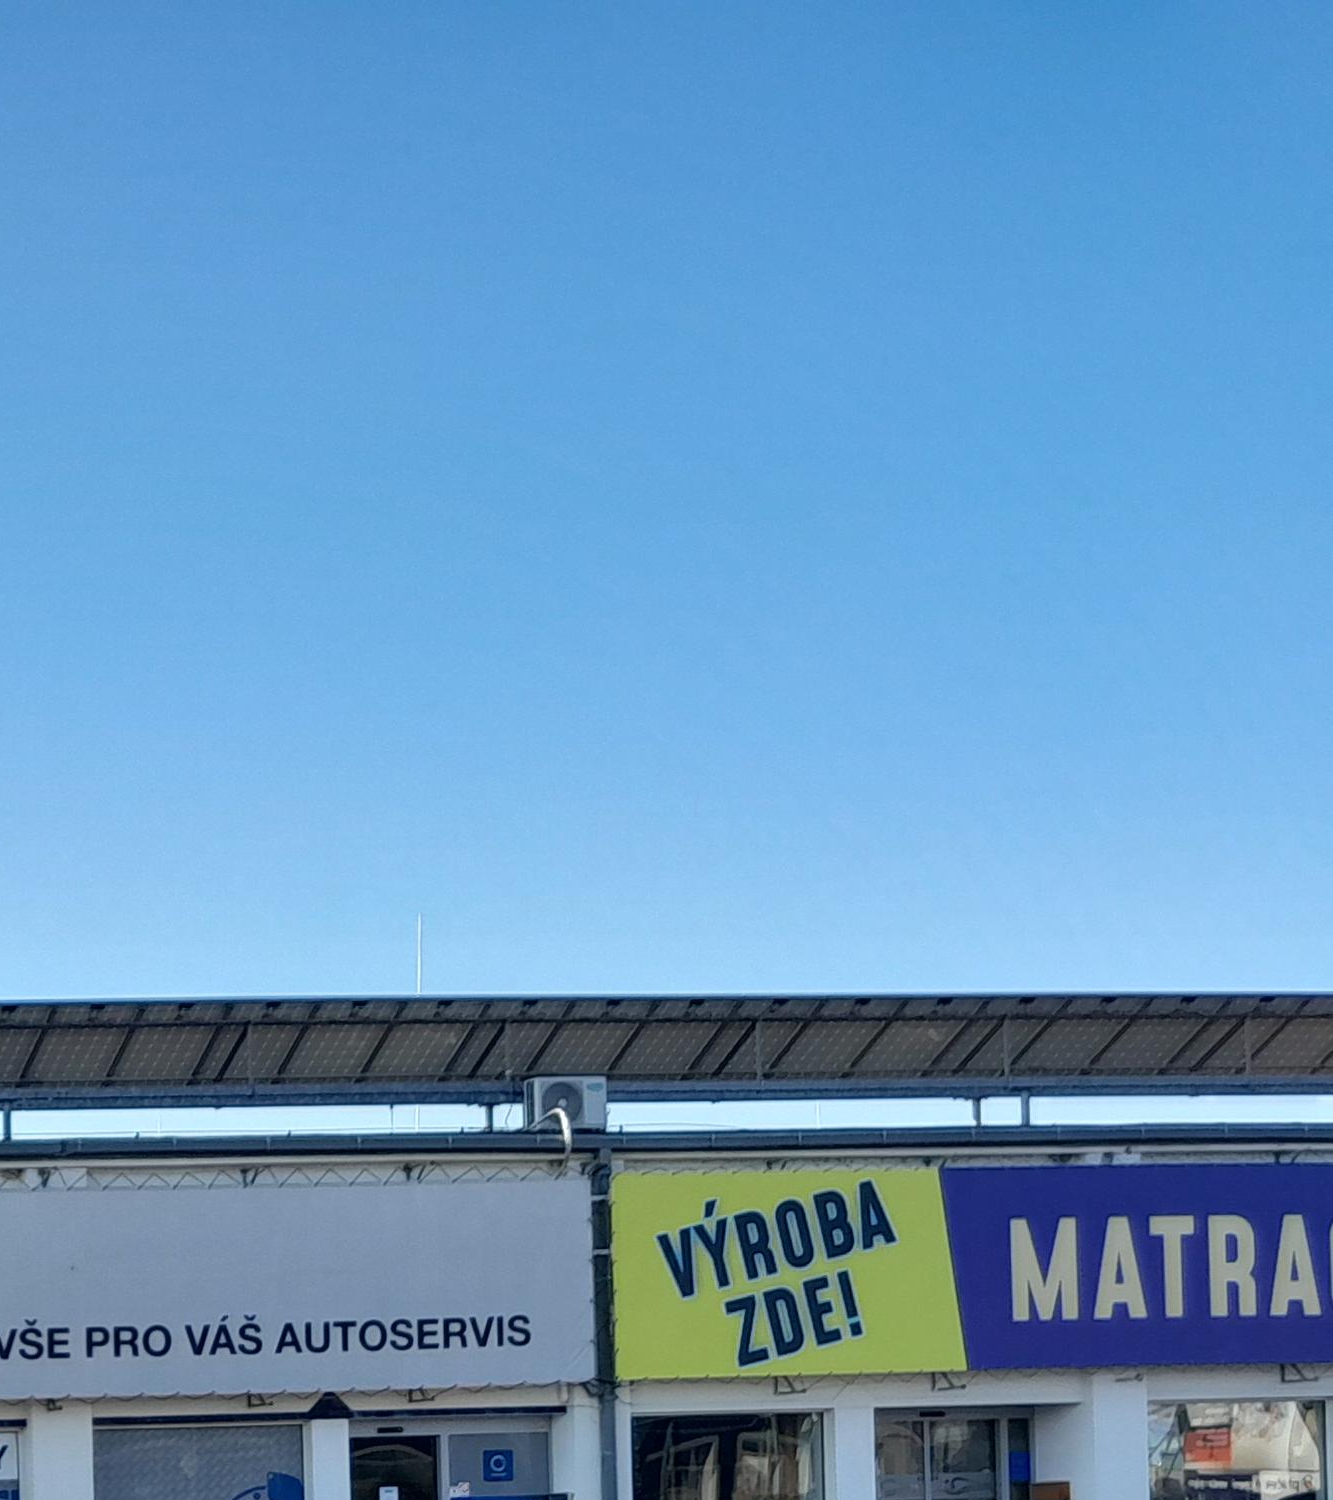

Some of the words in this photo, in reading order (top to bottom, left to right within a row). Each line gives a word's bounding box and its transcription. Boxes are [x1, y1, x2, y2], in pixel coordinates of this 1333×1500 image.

[655, 1179, 898, 1298] VÝROBA
[1010, 1213, 1333, 1321] MATRA
[85, 1323, 173, 1358] PRO
[185, 1315, 263, 1356] VÁŠ
[275, 1314, 532, 1354] AUTOSERVIS
[724, 1269, 864, 1367] ZDE!
